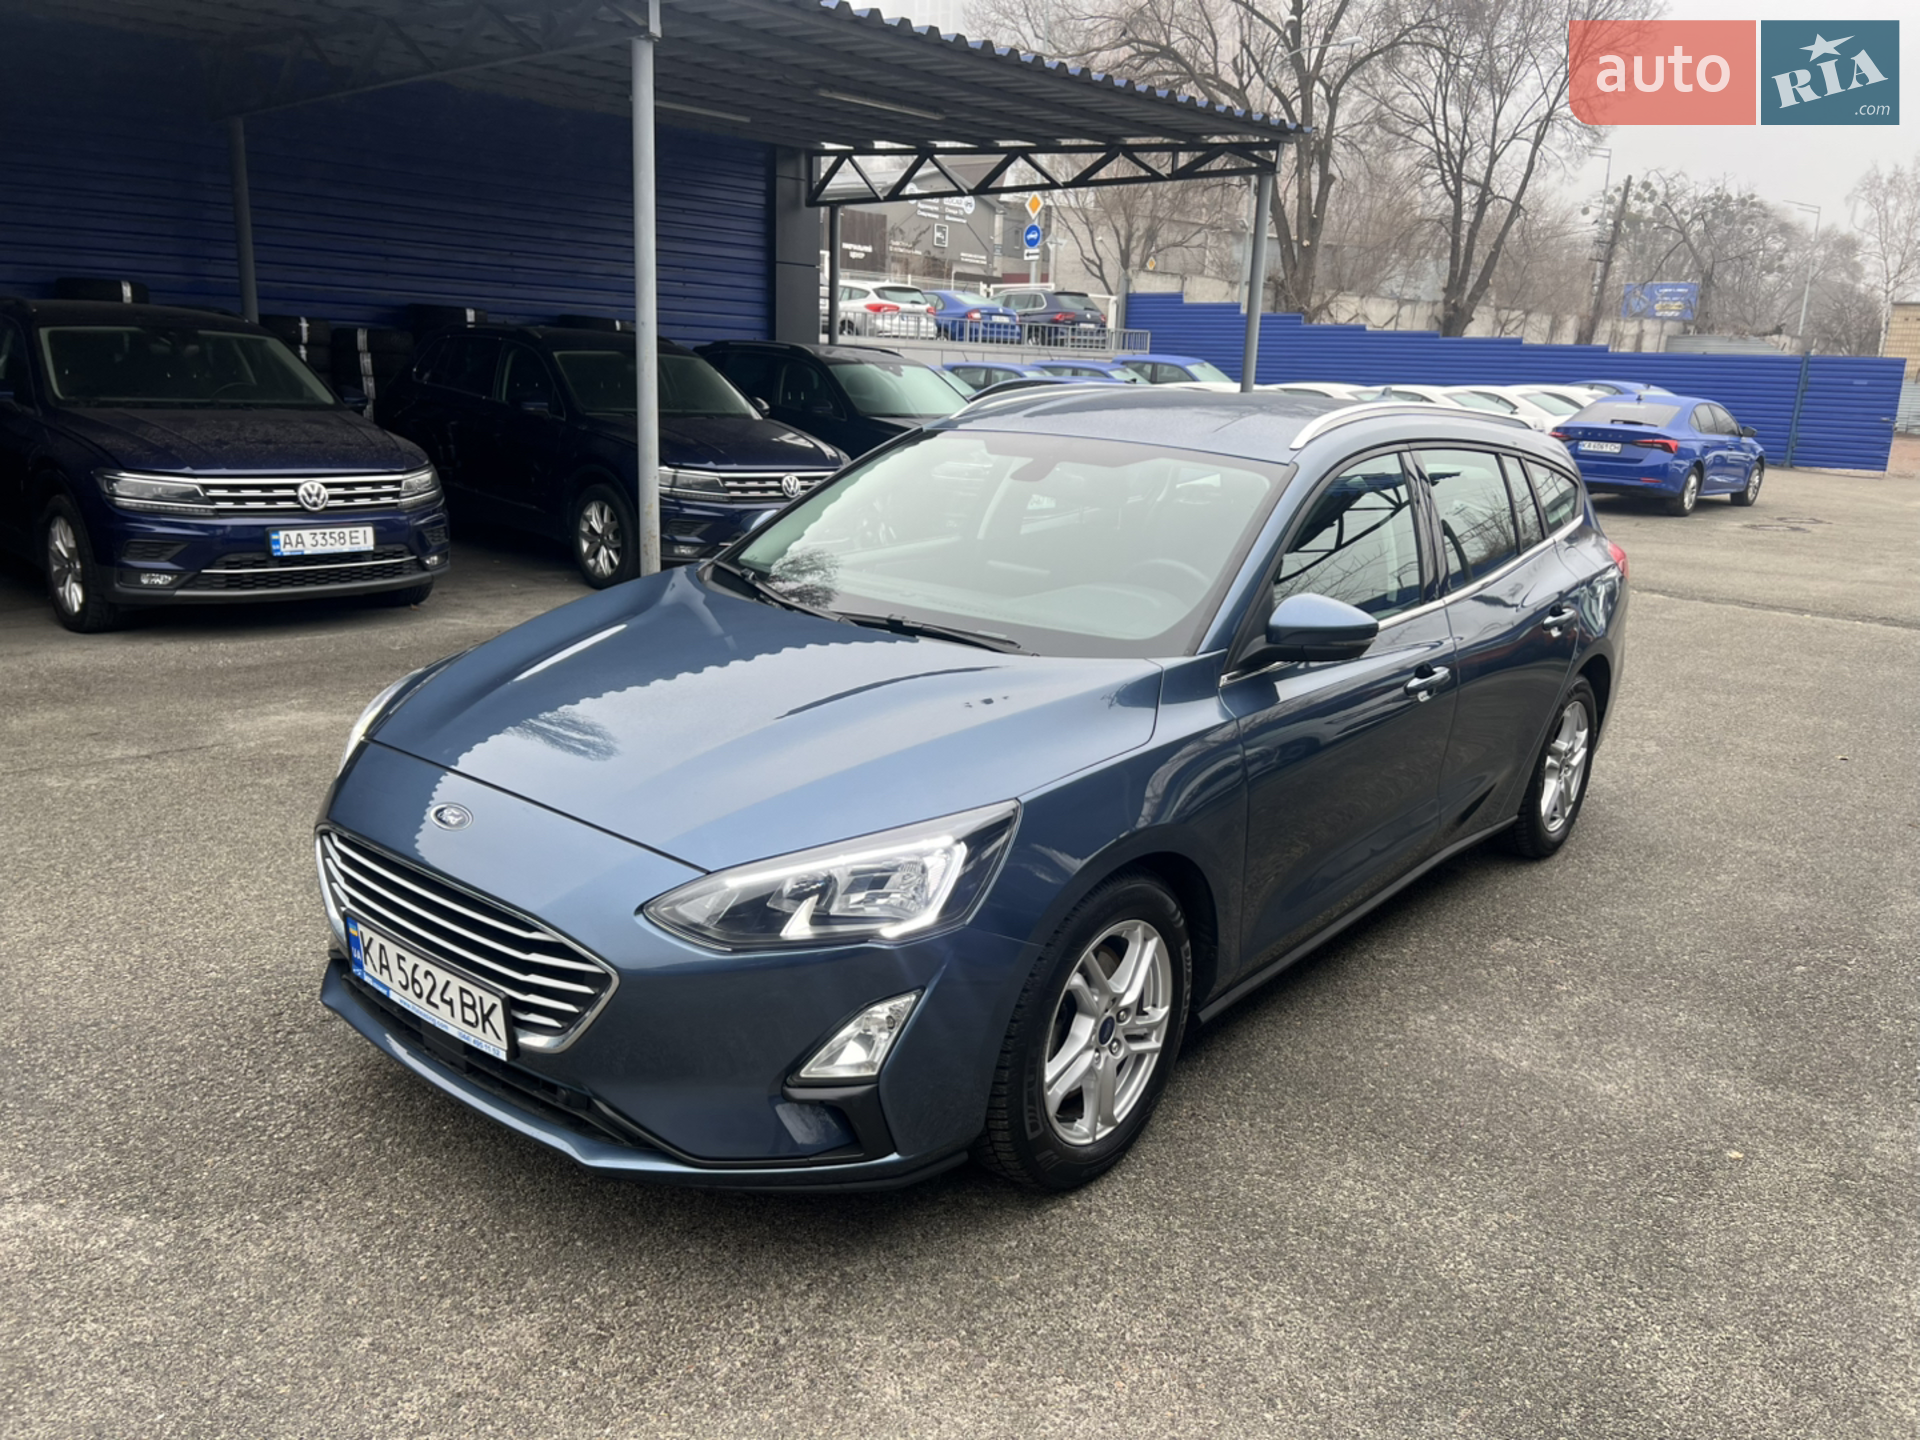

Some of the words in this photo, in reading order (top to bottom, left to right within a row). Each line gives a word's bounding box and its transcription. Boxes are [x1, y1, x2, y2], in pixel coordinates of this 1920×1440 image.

[282, 532, 306, 549] AA
[309, 530, 347, 547] 3358
[350, 529, 367, 545] EI
[352, 946, 362, 962] UA
[360, 930, 393, 983] KA
[396, 953, 455, 1018] 5624
[459, 986, 502, 1041] BK
